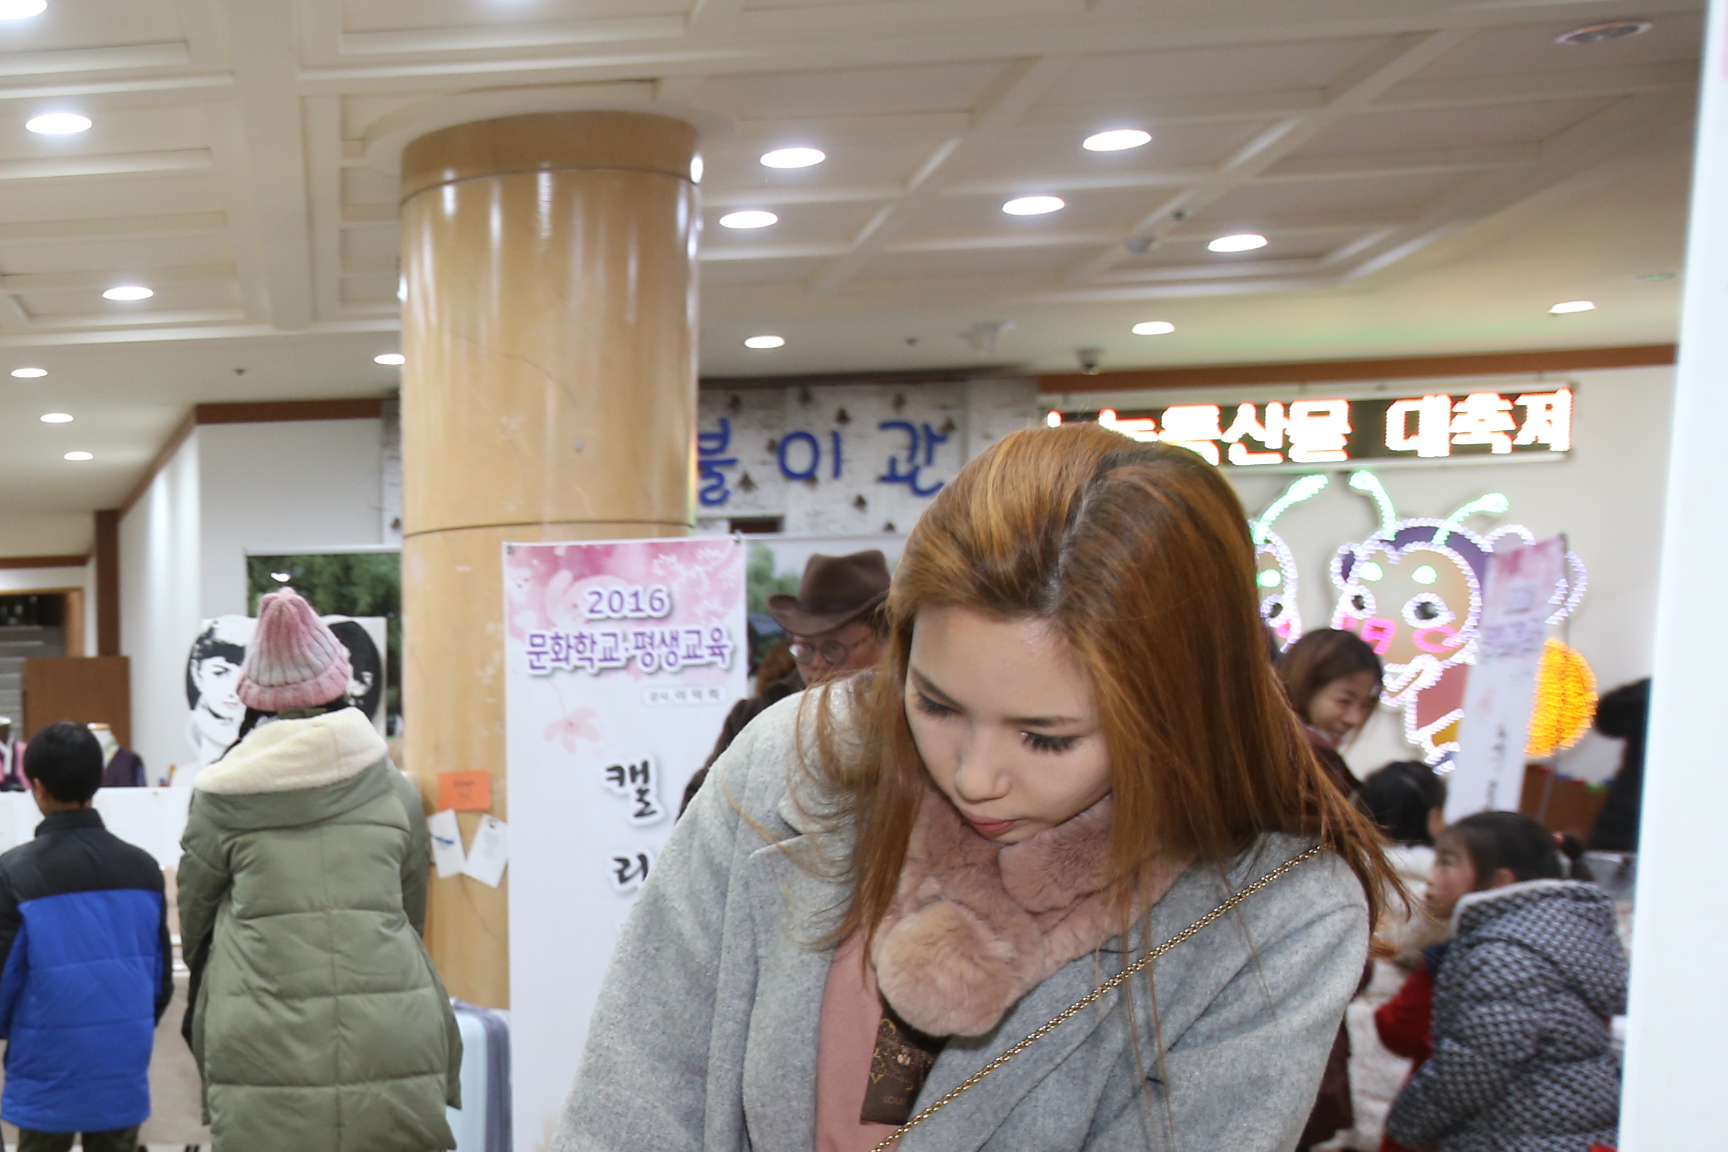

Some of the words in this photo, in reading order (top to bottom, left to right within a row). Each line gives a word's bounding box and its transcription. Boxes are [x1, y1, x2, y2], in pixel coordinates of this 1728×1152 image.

[1097, 398, 1353, 466] 특산물
[1383, 387, 1574, 458] 대축제
[586, 586, 668, 616] 2016
